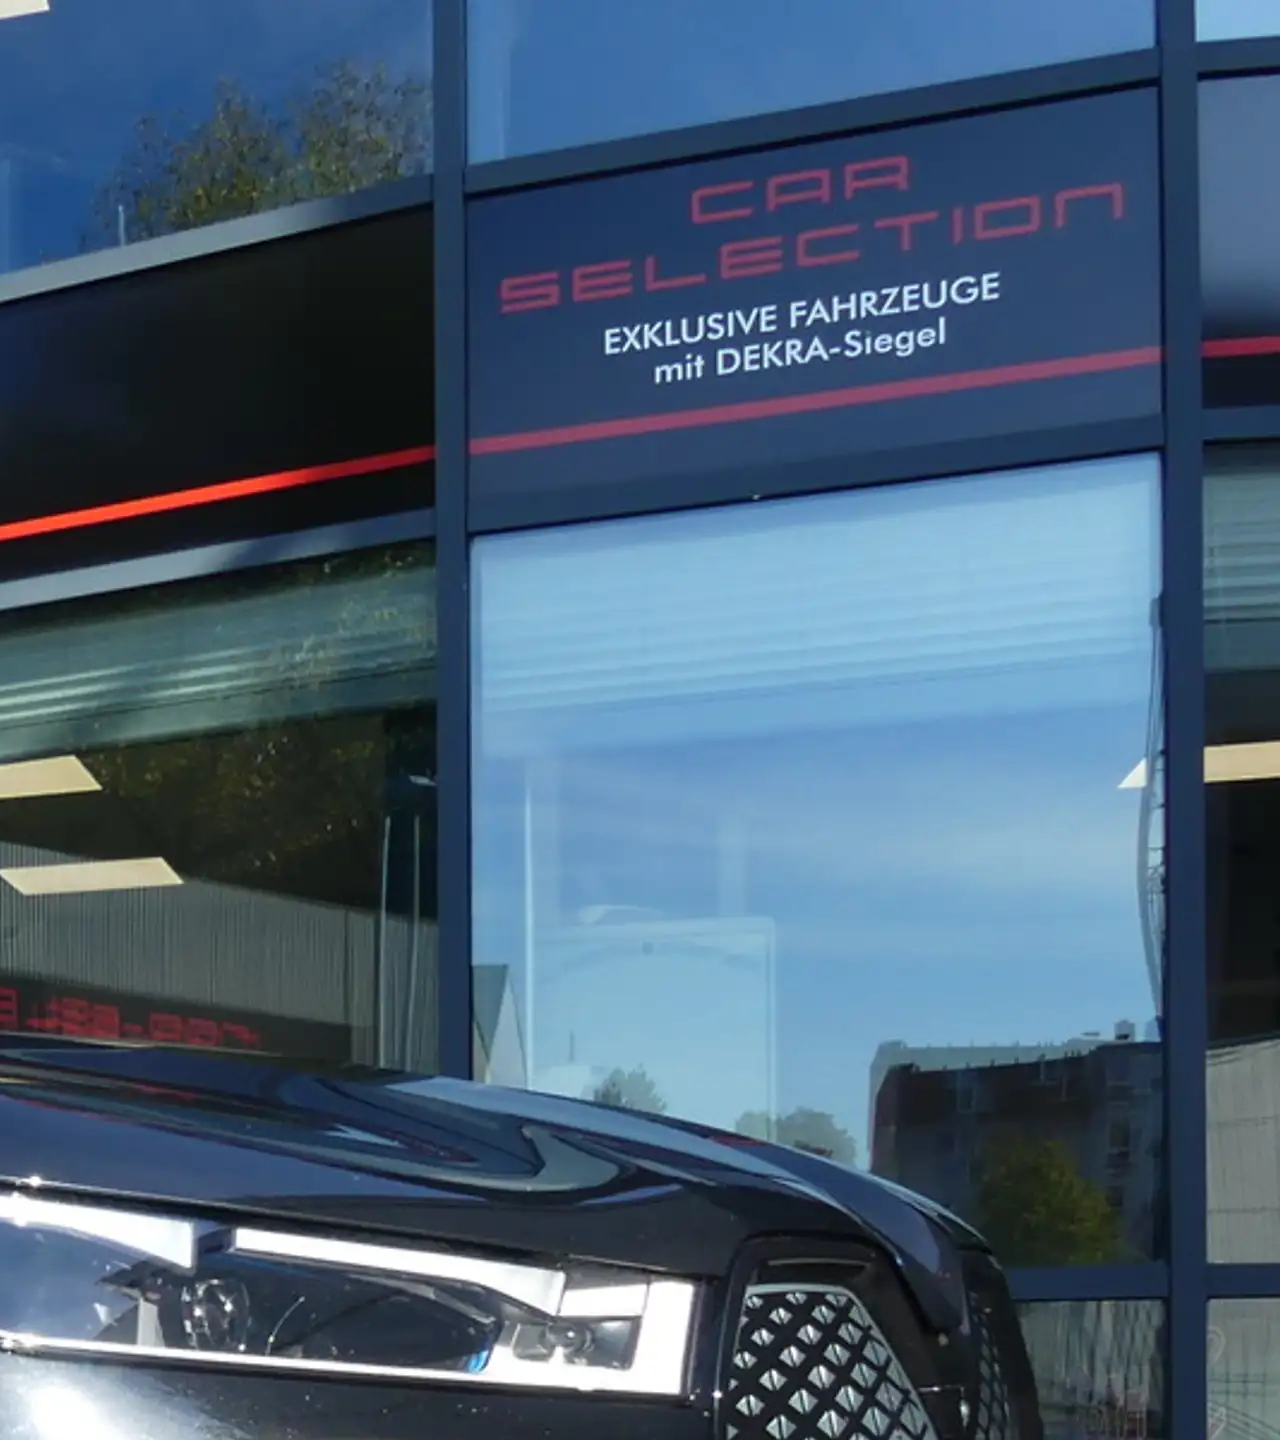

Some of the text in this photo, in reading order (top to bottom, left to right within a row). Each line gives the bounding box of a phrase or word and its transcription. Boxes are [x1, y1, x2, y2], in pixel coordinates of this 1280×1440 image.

[691, 154, 910, 225] CAR
[500, 182, 1125, 314] SELECTION
[603, 271, 1002, 356] EXKLUSIVE FAHRZEUGE
[653, 316, 947, 385] mit DEKRA-Siegel
